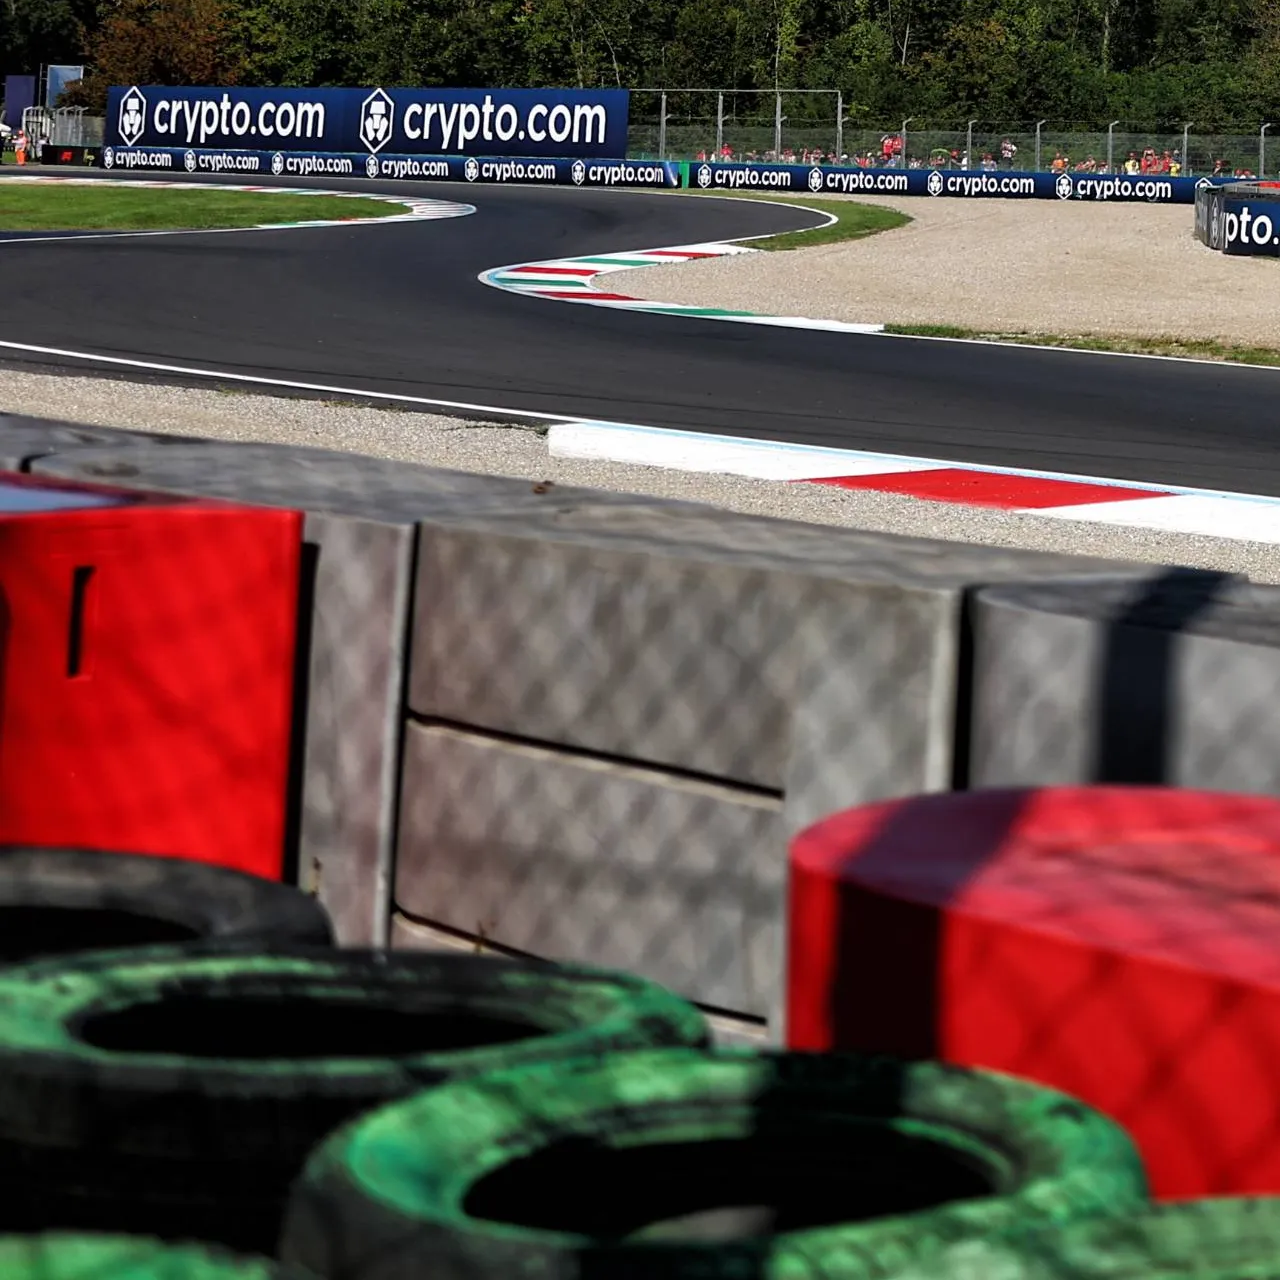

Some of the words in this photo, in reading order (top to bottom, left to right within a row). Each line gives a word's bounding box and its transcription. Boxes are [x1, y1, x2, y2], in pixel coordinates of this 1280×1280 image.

[153, 93, 325, 143] crypto.com
[404, 95, 606, 149] crypto.com
[115, 150, 171, 167] crypto.com
[198, 152, 260, 171] crypto.com
[286, 156, 353, 174] crypto.com
[381, 158, 448, 178] crypto.com
[482, 161, 556, 180] crypto.com
[588, 163, 664, 185] crypto.com
[714, 168, 790, 190] crypto.com
[826, 171, 907, 193] crypto.com
[946, 174, 1034, 197] crypto.com
[1076, 177, 1172, 201] crypto.com
